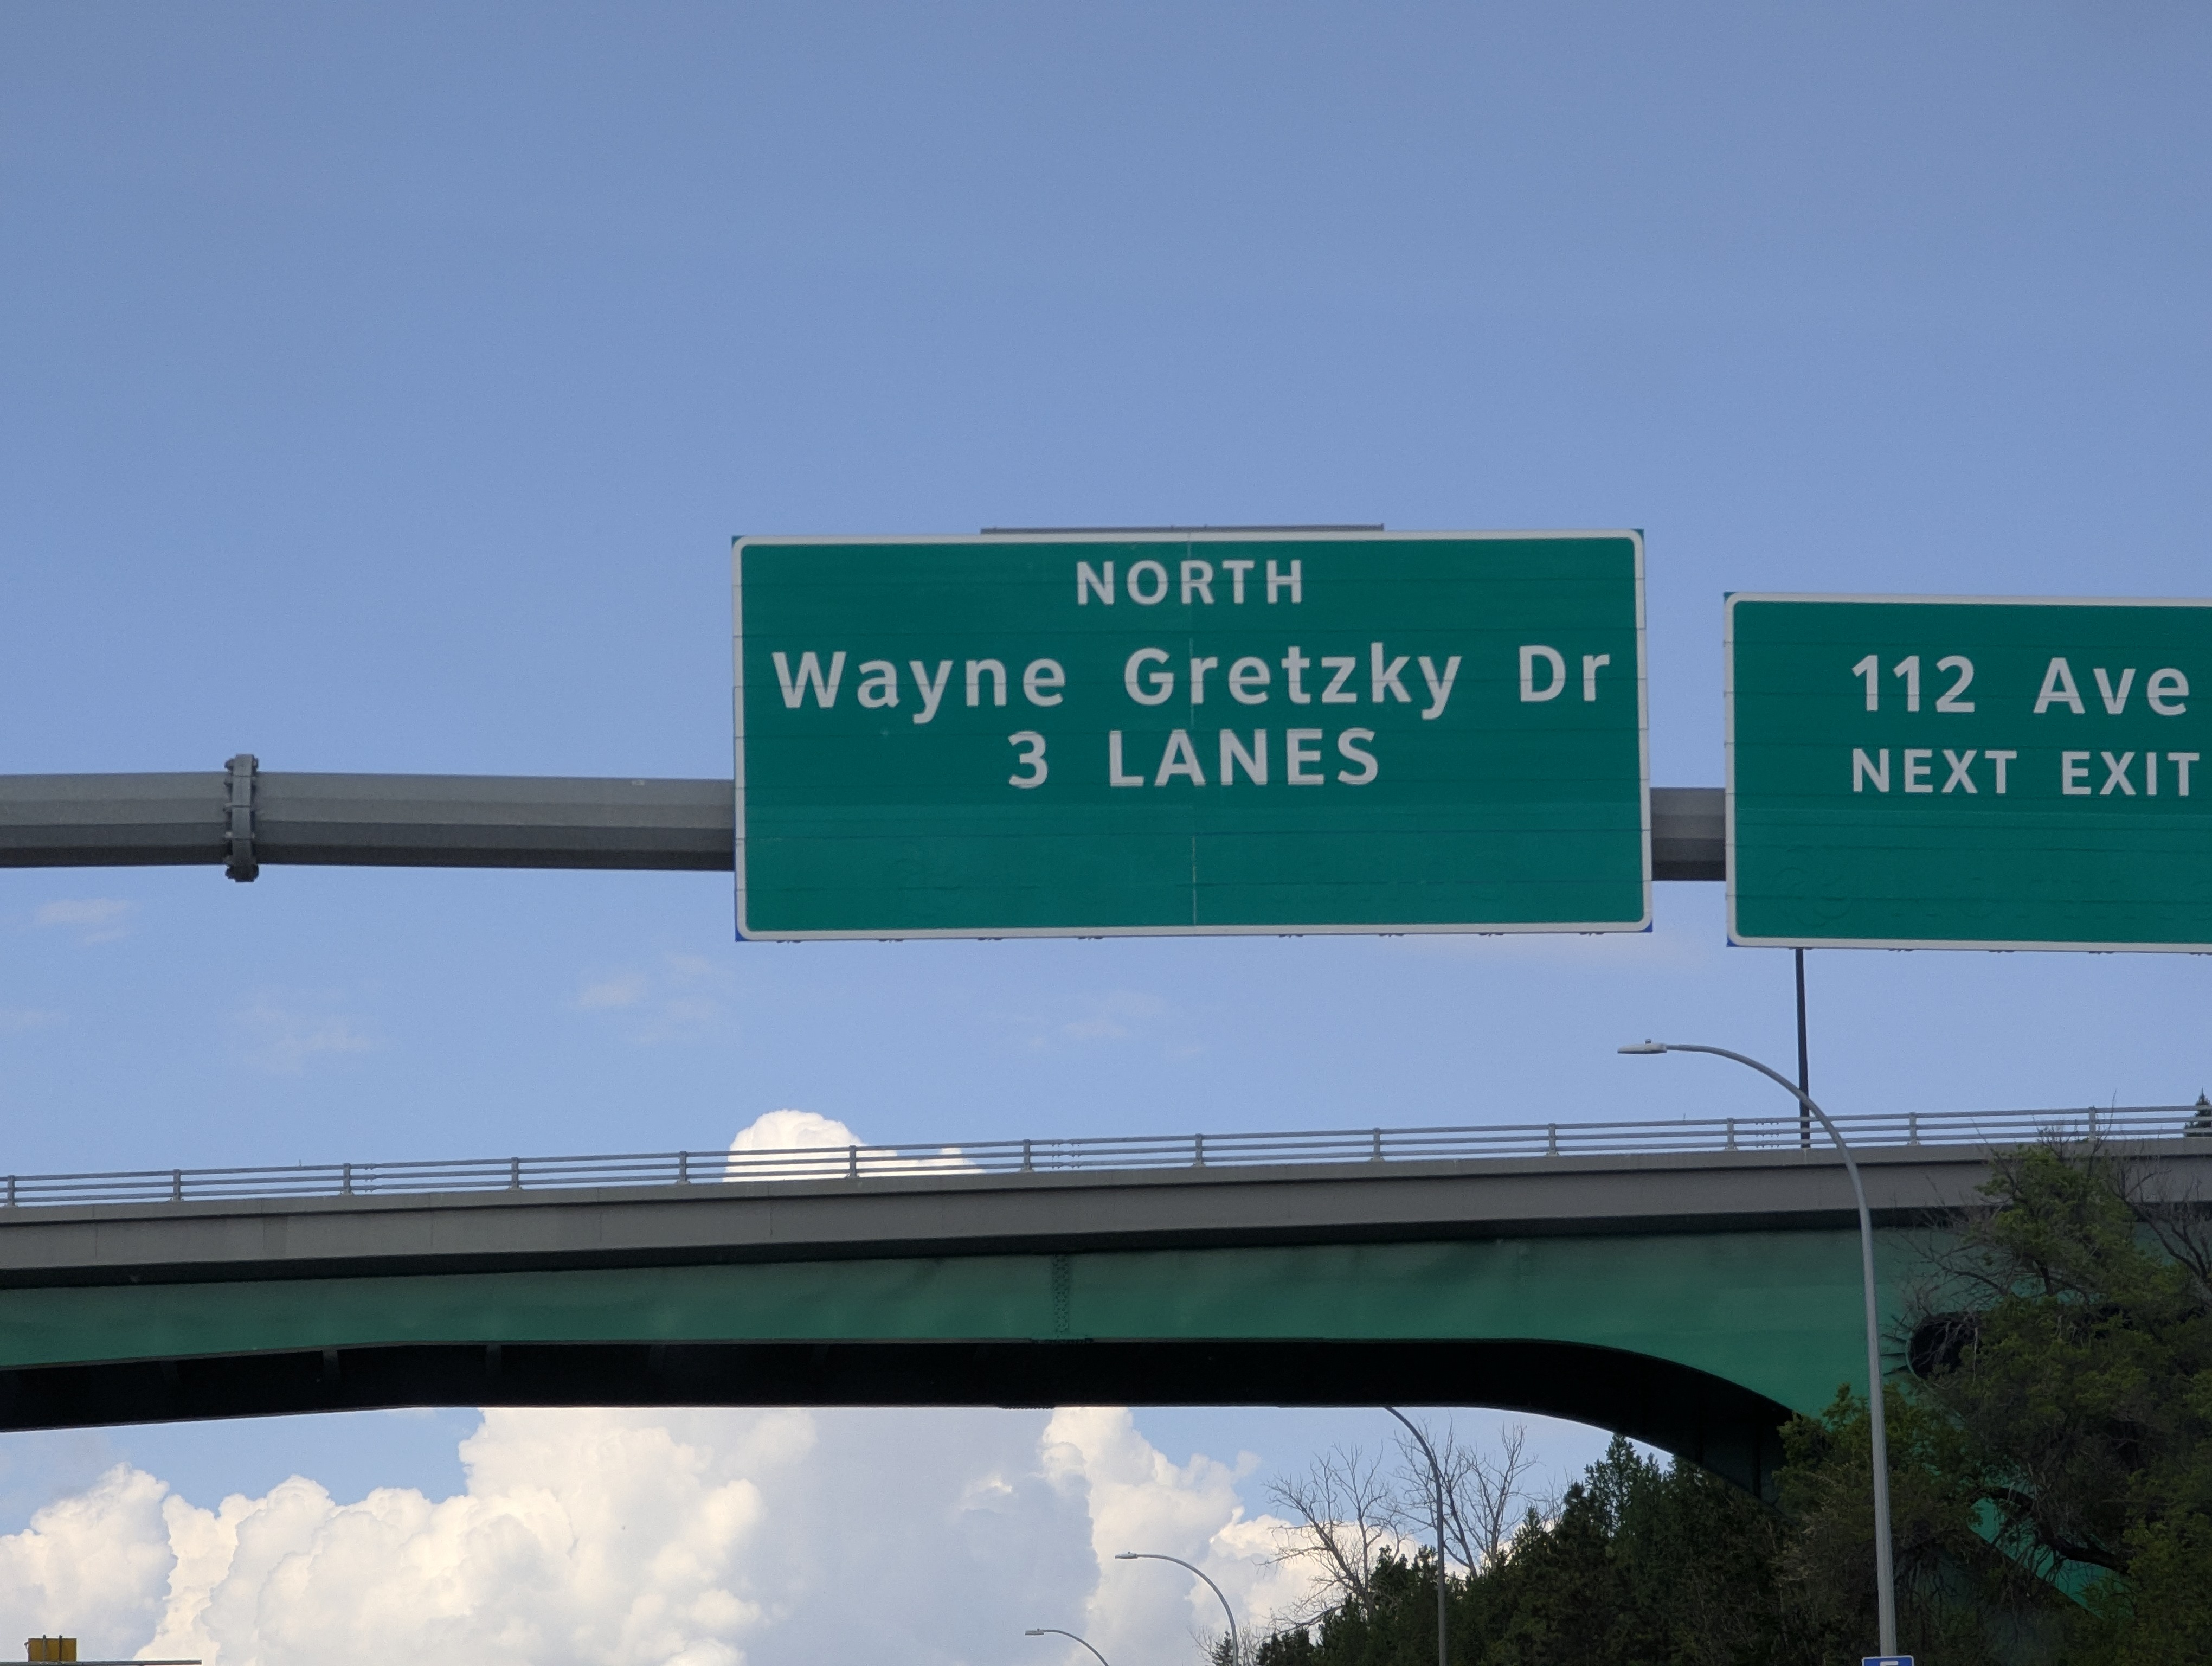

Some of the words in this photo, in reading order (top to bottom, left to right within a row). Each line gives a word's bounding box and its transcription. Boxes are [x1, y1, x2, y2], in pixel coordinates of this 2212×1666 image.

[1077, 560, 1301, 605] NORTH
[773, 652, 1065, 724] Wayne
[1124, 643, 1461, 720] Gretzky
[1519, 645, 1610, 702] Dr
[1852, 655, 1975, 713] 112
[2034, 658, 2189, 716] Ave
[1009, 731, 1048, 789] 3
[1110, 728, 1378, 786] LANES
[1853, 749, 2017, 794] NEXT
[2062, 752, 2200, 796] EXIT
